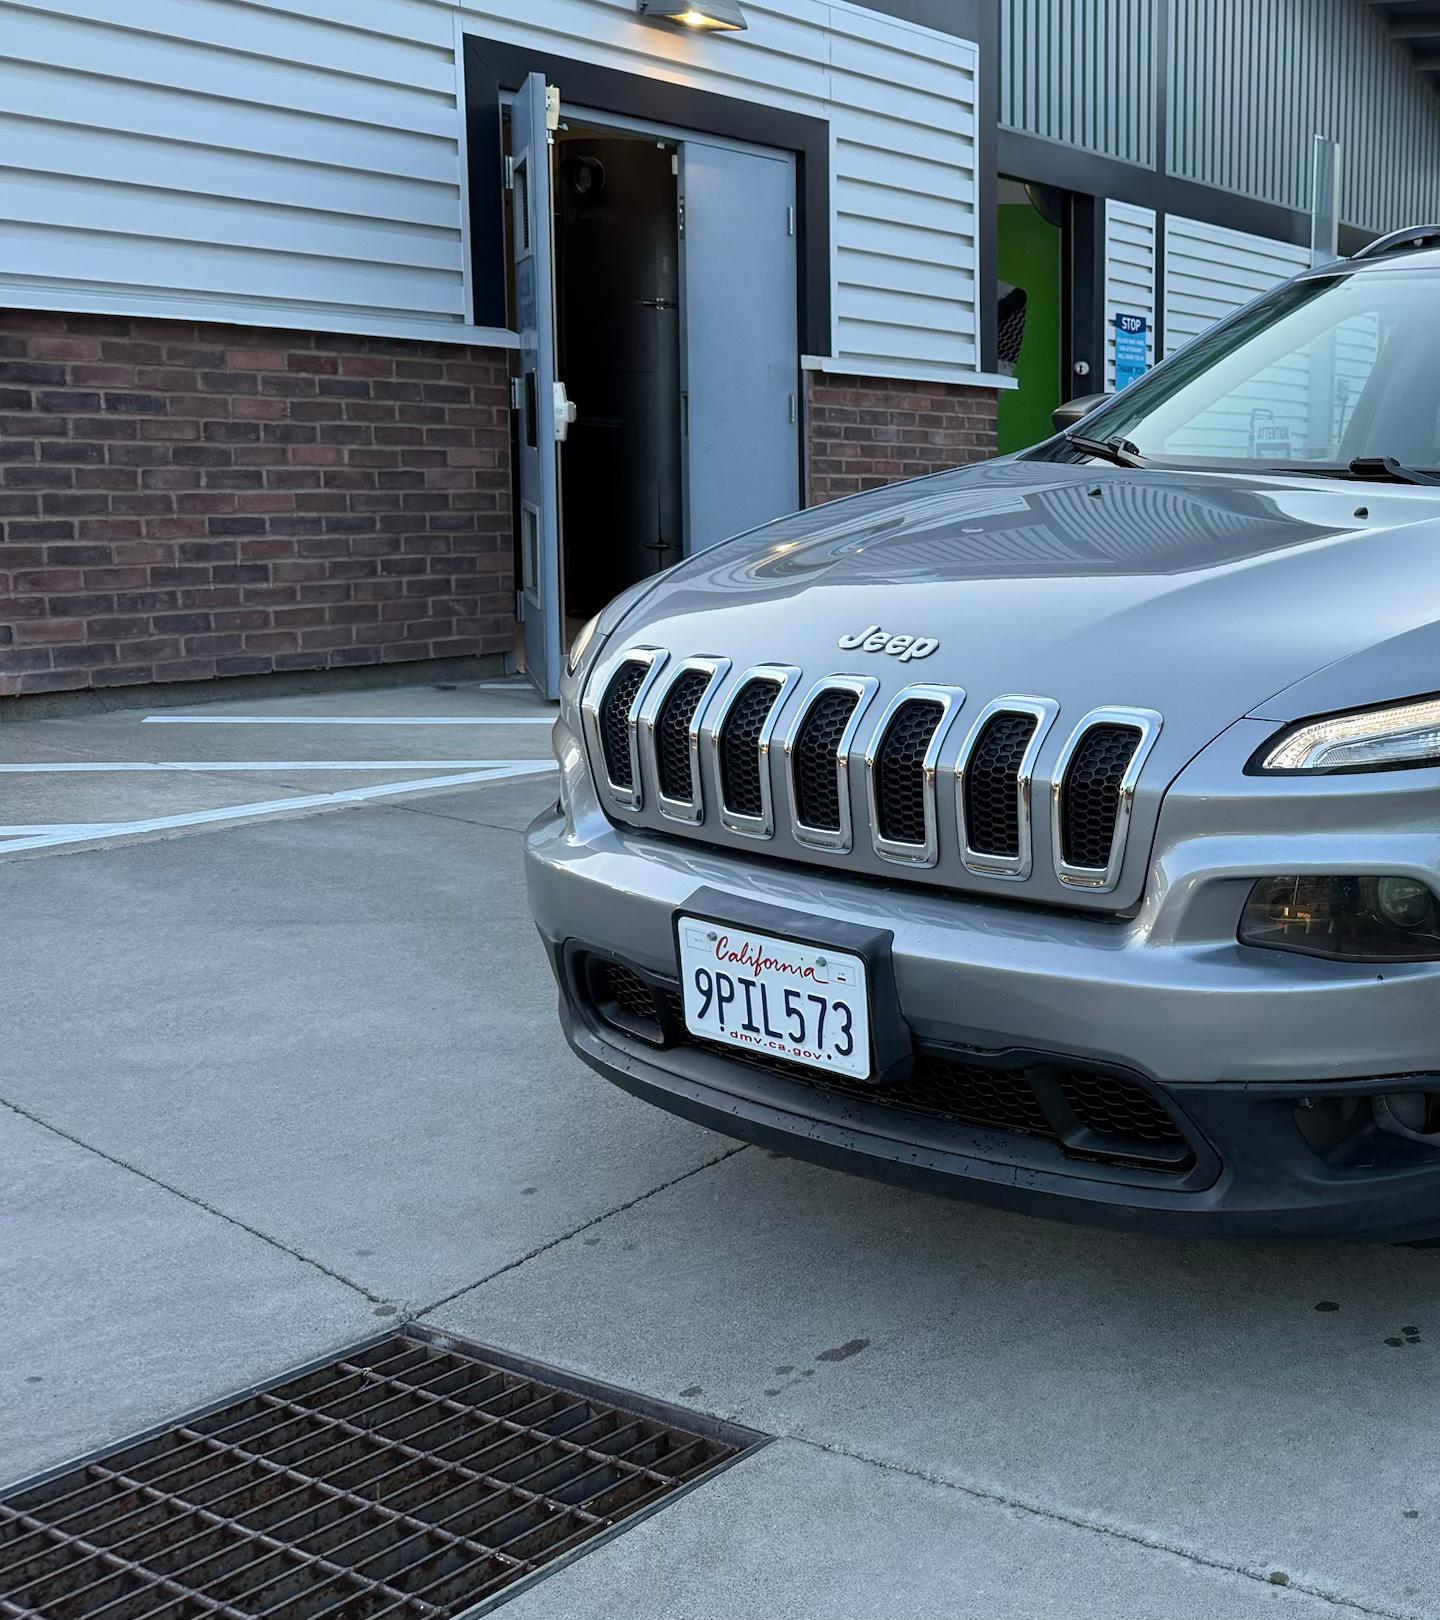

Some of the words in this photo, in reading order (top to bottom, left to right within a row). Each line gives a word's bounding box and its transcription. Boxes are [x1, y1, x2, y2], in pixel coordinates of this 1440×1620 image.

[1121, 317, 1142, 331] STOP
[1257, 426, 1290, 441] ATTENTION
[838, 624, 940, 663] Jeep
[715, 936, 830, 984] California
[694, 968, 854, 1056] 9PIL573
[730, 1030, 822, 1061] dmv.ca.gov
